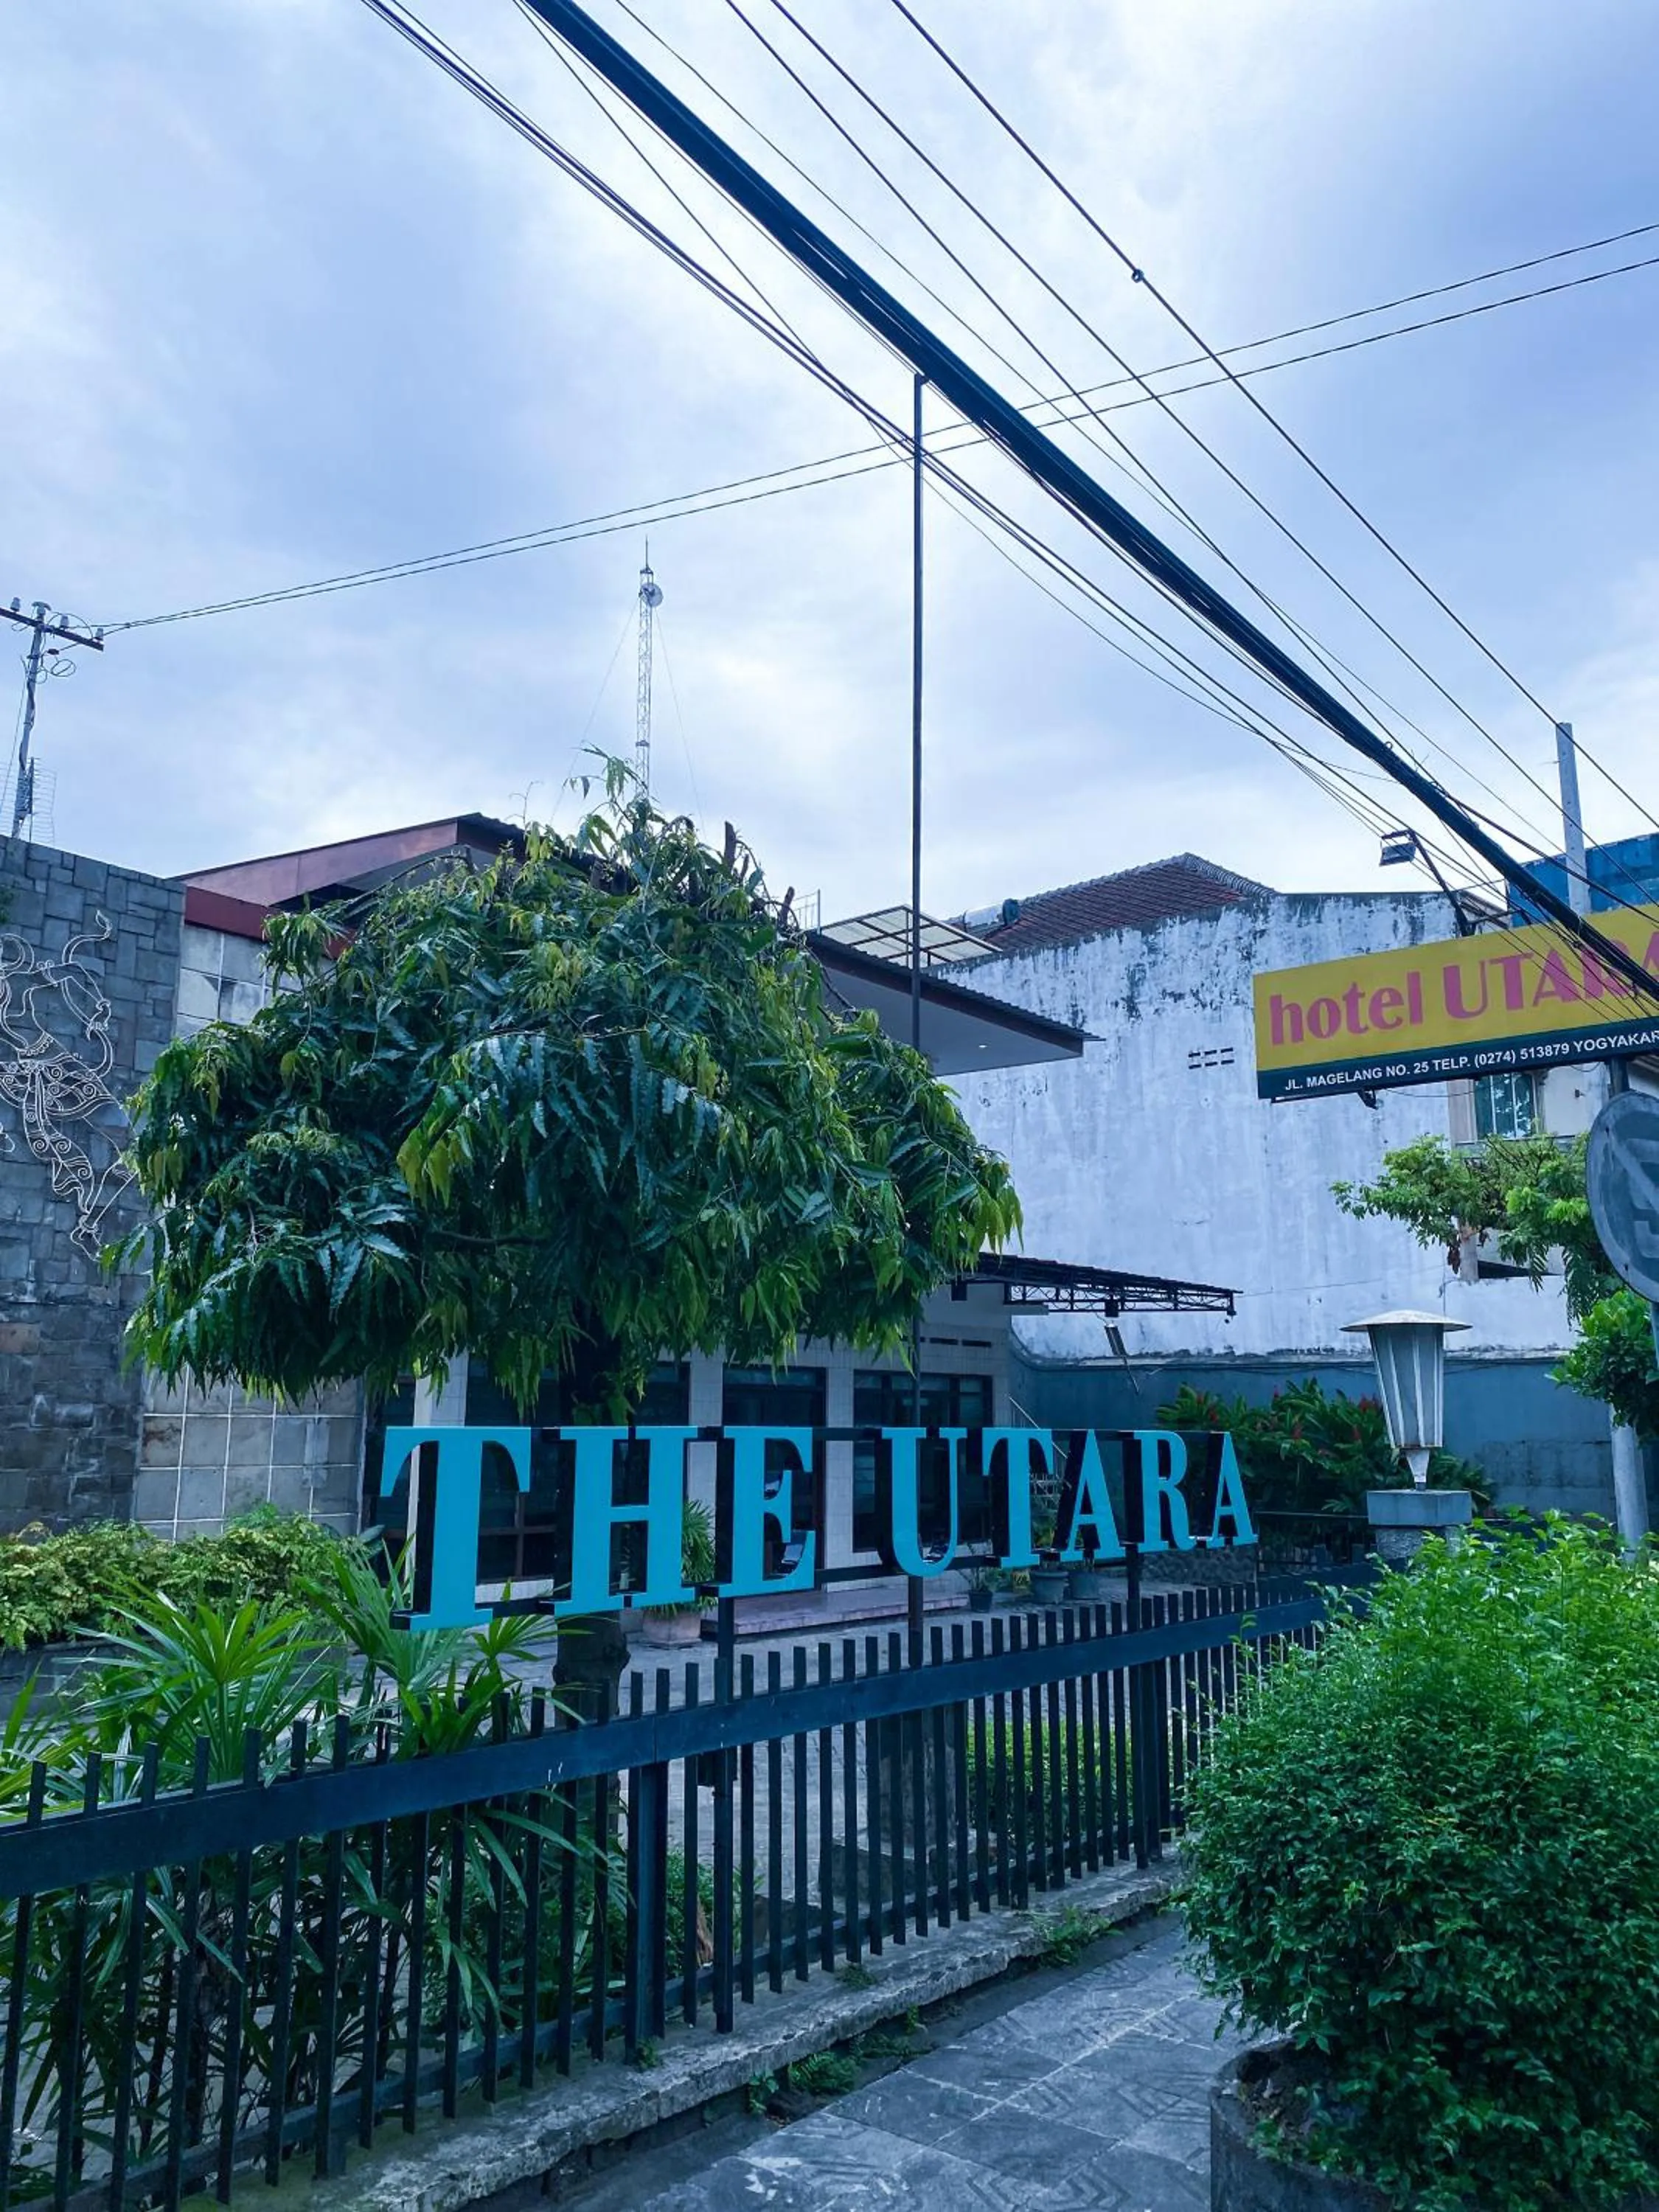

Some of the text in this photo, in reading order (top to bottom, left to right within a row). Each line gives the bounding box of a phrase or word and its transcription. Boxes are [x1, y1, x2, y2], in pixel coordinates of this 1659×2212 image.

[1270, 971, 1423, 1045] hotel
[1285, 1079, 1303, 1091] JL.
[1307, 1068, 1382, 1088] MAGELANG
[1385, 1064, 1411, 1078] NO.
[1413, 1061, 1429, 1074] 25
[1432, 1056, 1470, 1072] TELP.
[1475, 1049, 1516, 1068] (0274)
[1520, 1043, 1570, 1060] 513879
[380, 1426, 1259, 1631] THE UTARA
